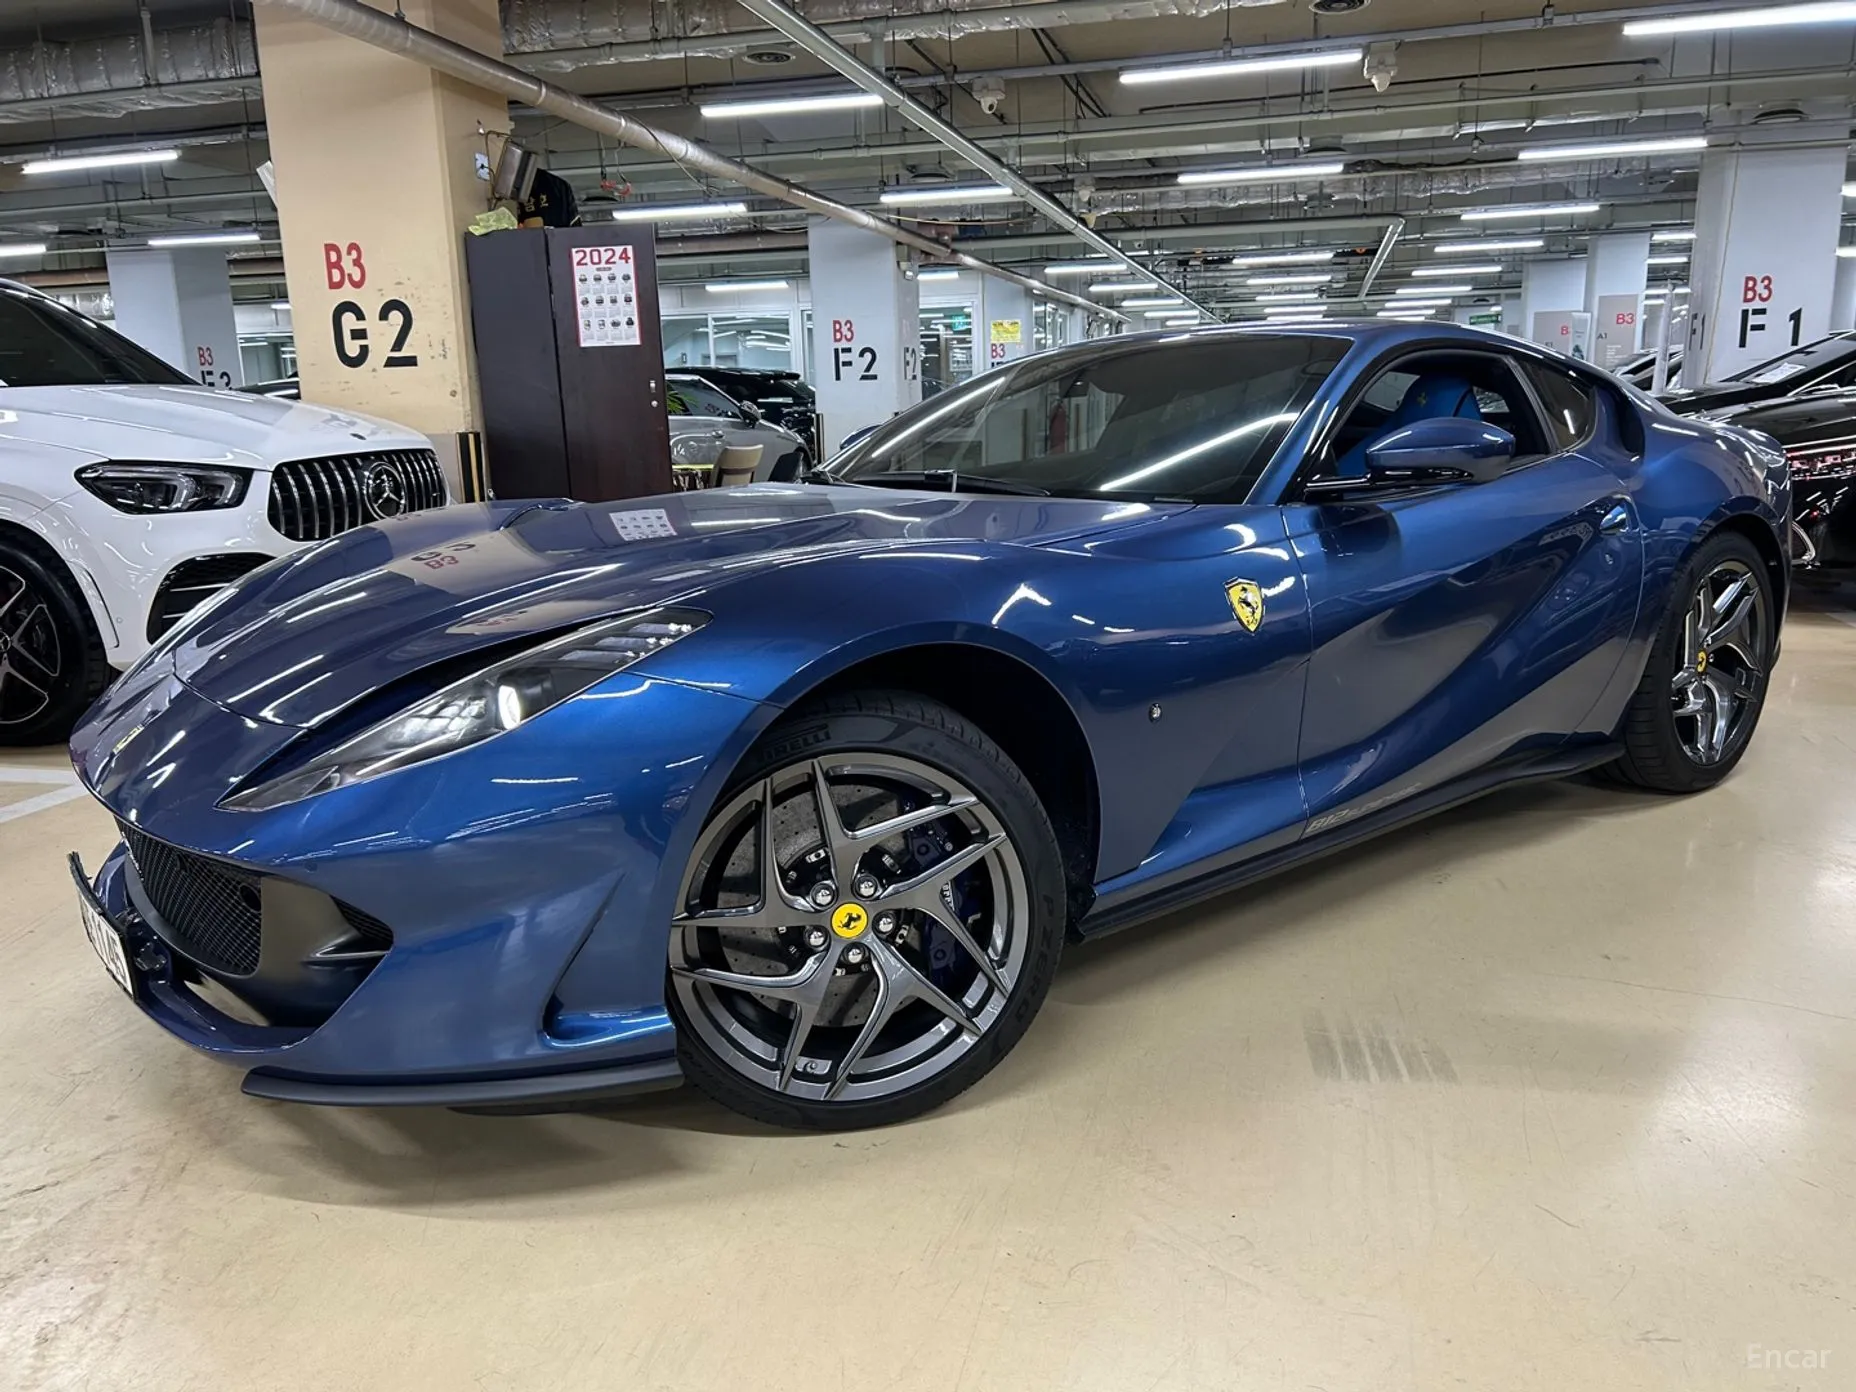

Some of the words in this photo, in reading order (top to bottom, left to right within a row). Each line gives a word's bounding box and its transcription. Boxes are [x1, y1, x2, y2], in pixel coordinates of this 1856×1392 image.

[324, 242, 366, 289] B3
[574, 247, 631, 266] 2024
[1742, 275, 1773, 303] B3
[1616, 313, 1635, 325] B3
[832, 319, 855, 342] B3
[1560, 325, 1569, 336] B
[197, 346, 214, 366] B3
[991, 343, 1005, 359] B3
